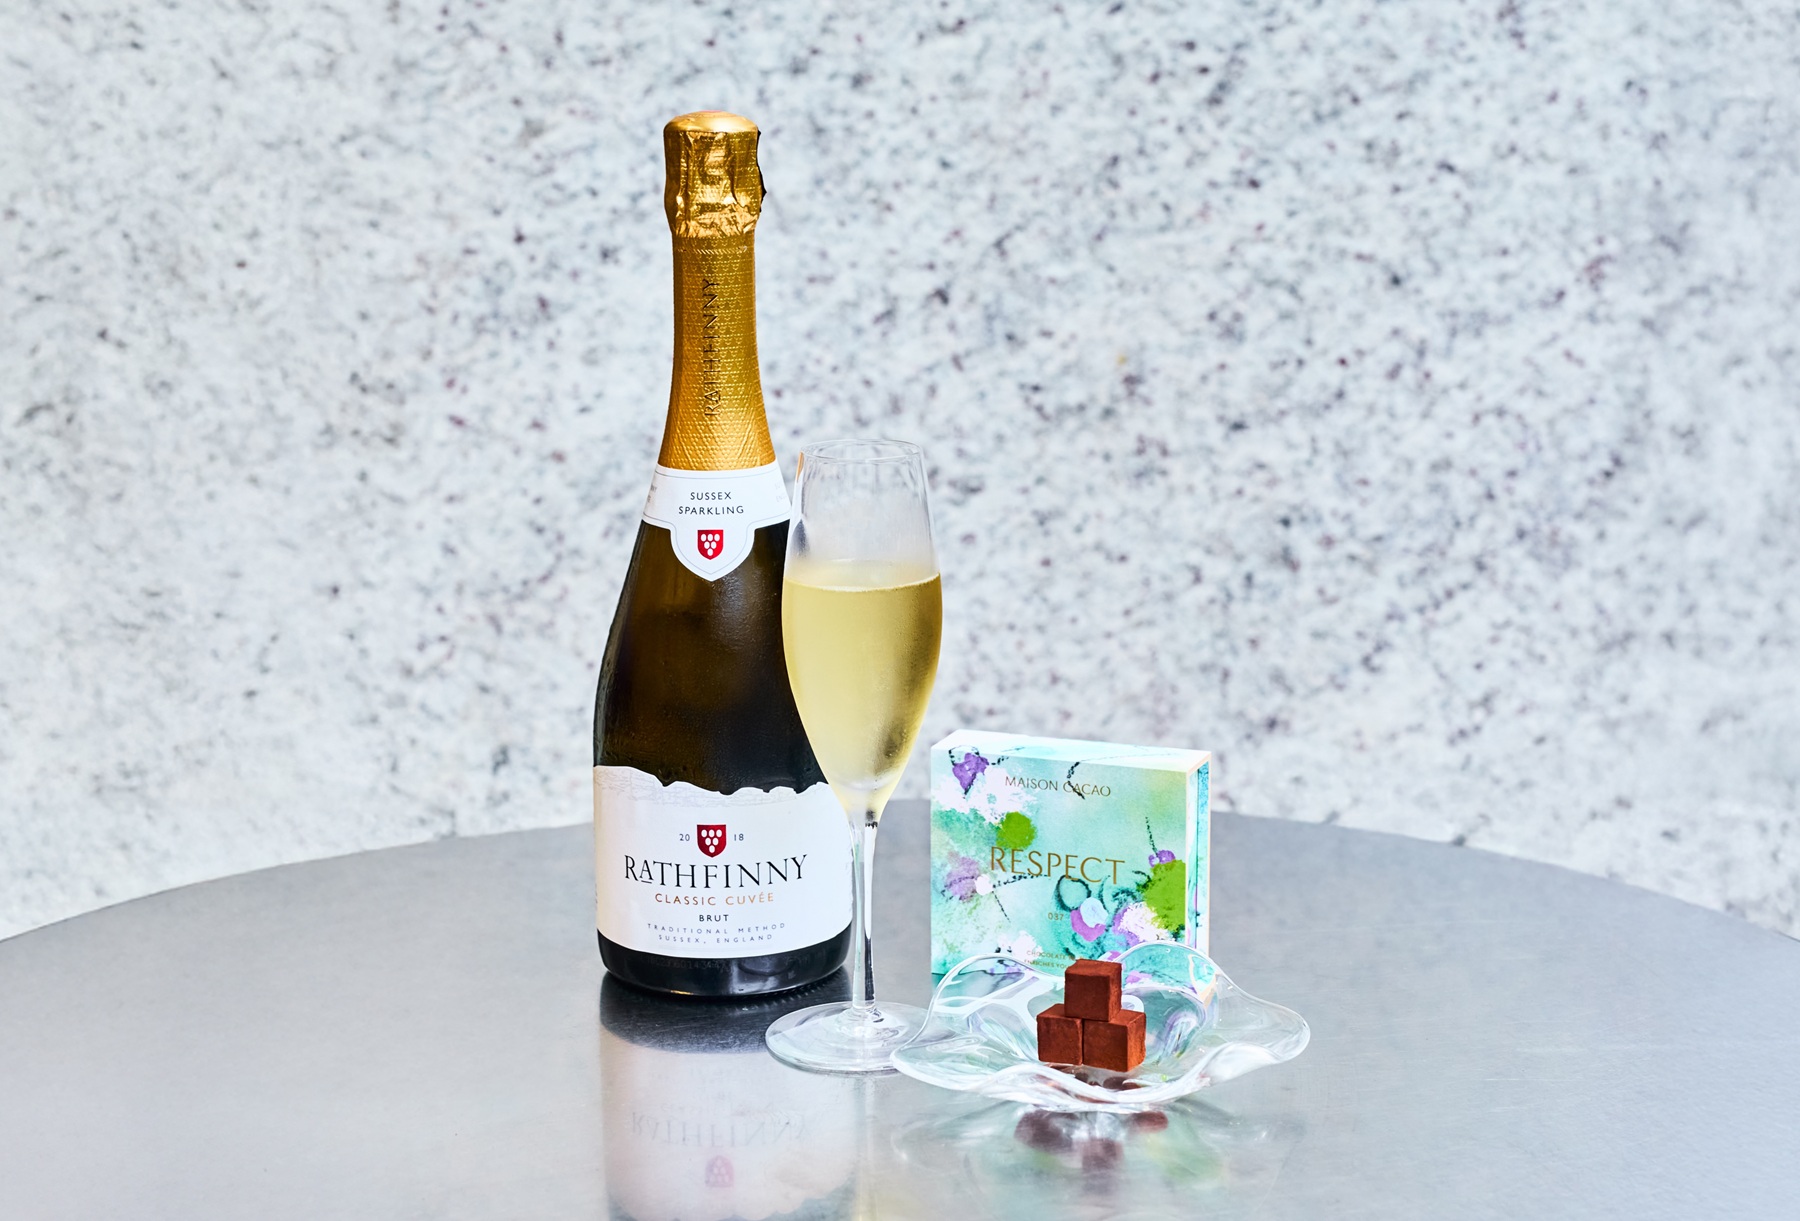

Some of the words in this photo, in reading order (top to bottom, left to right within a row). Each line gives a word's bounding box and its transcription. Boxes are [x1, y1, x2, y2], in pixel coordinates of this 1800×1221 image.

[702, 278, 722, 416] RATHFINNY
[690, 491, 732, 501] SUSSEX
[678, 505, 744, 516] SPARKLING
[1005, 776, 1058, 791] MAISON
[1062, 782, 1112, 798] CACAO
[679, 833, 691, 842] 20
[734, 833, 744, 842] 18
[990, 846, 1125, 884] RESPECT
[624, 854, 807, 888] RATHFINNY
[654, 893, 717, 906] CLASSIC
[725, 891, 775, 906] CUVÉE
[698, 914, 730, 922] BRUT
[1047, 911, 1065, 922] 037
[647, 923, 729, 934] TRADITIONAL
[737, 922, 786, 933] METHOD
[658, 934, 708, 944] SUSSEX,
[716, 934, 773, 944] ENGLAND
[1026, 949, 1067, 960] CHOCOLATE
